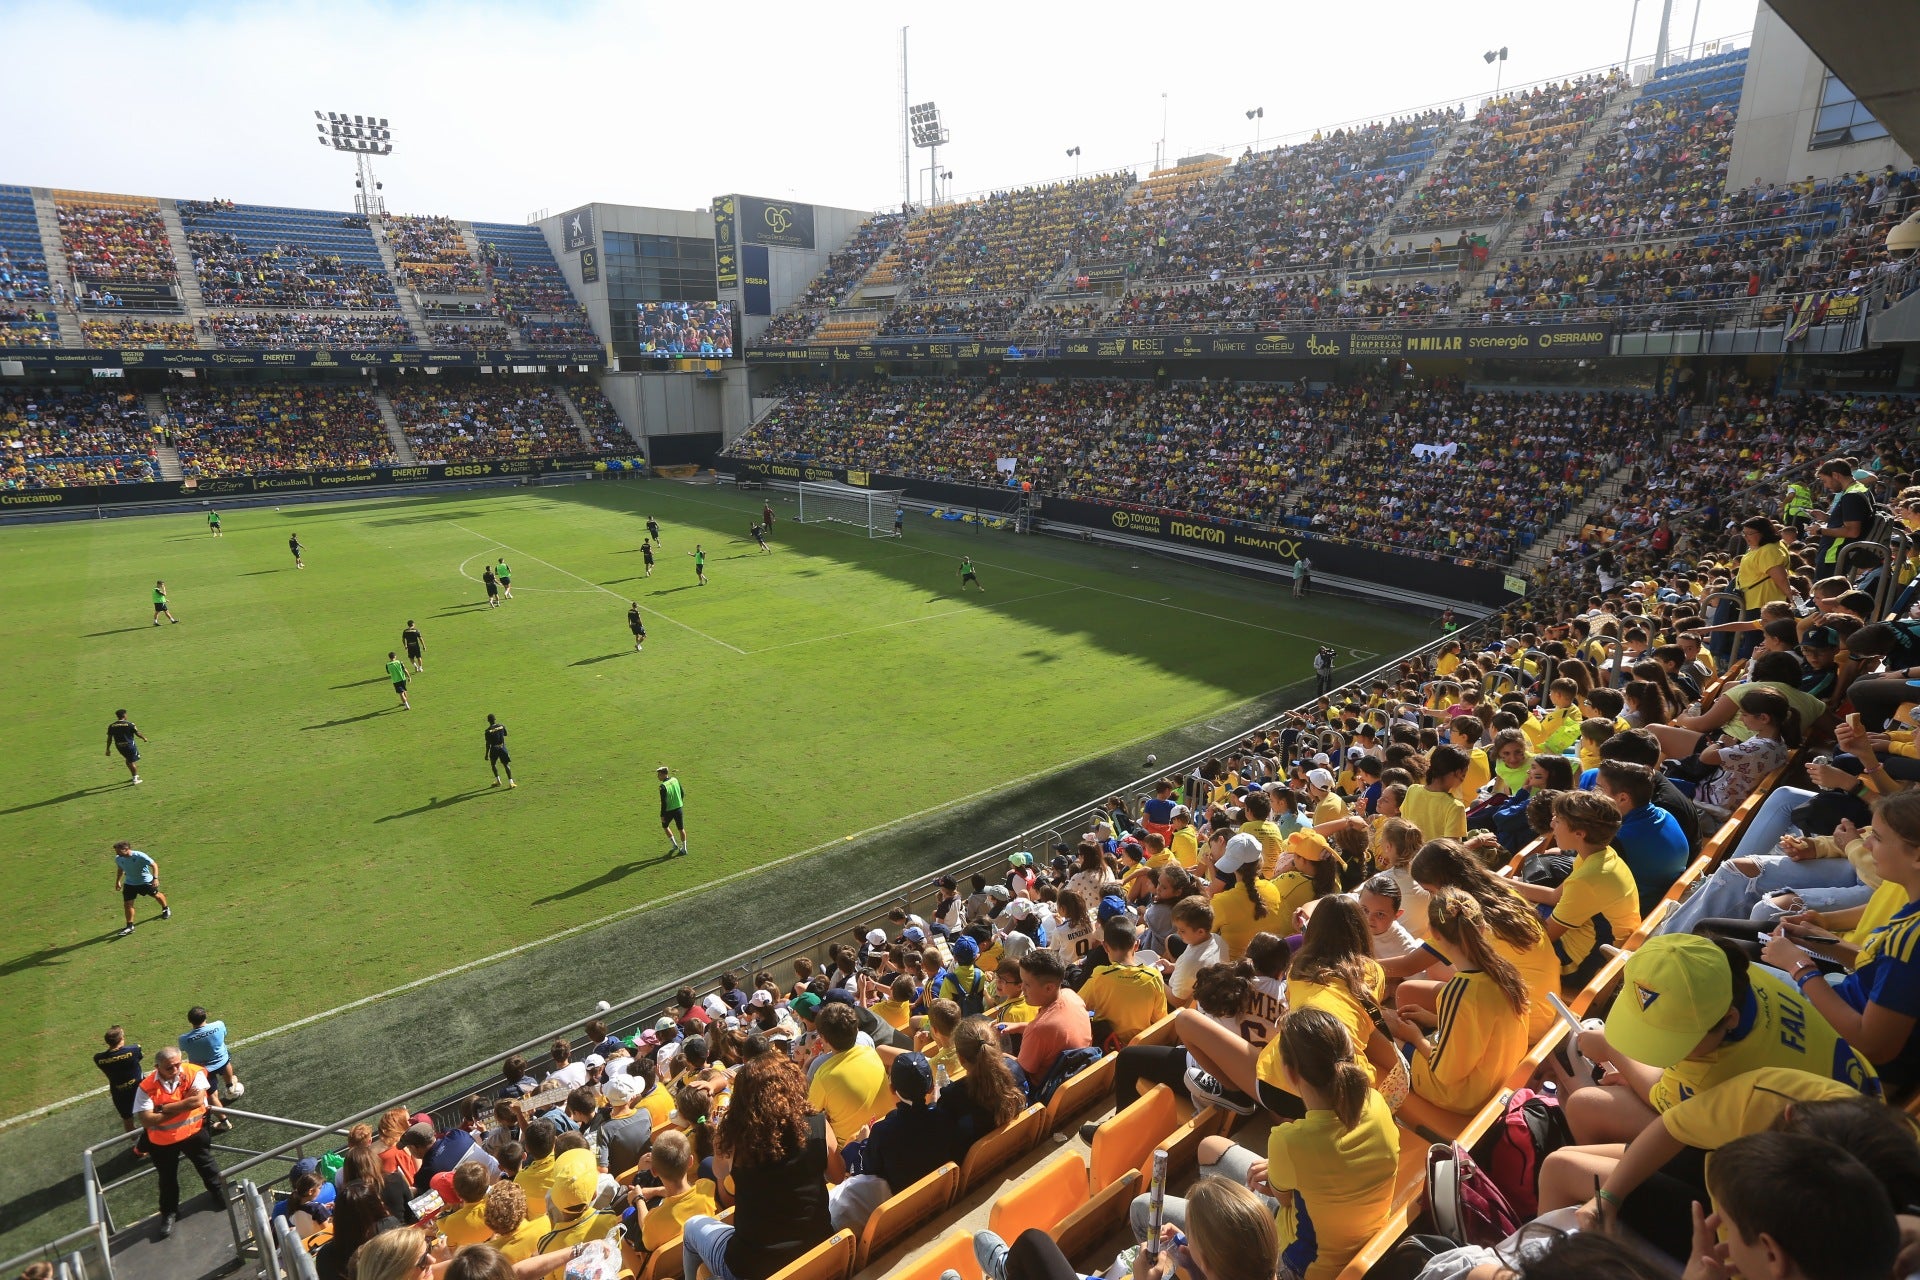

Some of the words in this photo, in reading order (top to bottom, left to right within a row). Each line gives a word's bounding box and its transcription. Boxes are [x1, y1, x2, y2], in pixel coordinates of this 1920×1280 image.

[745, 277, 762, 285] asisa
[1553, 332, 1604, 343] SERRANO
[929, 344, 953, 354] RESET
[1132, 338, 1165, 351] RESET
[1255, 342, 1295, 351] COHEBU
[1420, 336, 1463, 351] MILAR
[262, 354, 296, 362] ENERYETI
[392, 467, 429, 477] ENERYETI
[444, 465, 482, 477] asisa
[772, 465, 800, 478] macron
[815, 469, 834, 478] TOYOTA
[270, 478, 308, 487] CaixaBank
[321, 475, 346, 484] Grupo
[346, 474, 371, 482] Solera
[1, 494, 62, 505] Cruzcampo
[1131, 513, 1161, 526] TOYOTA
[1170, 521, 1226, 544] macron
[1777, 991, 1806, 1054] FALI
[188, 1026, 220, 1043] macron
[98, 1051, 133, 1065] macron
